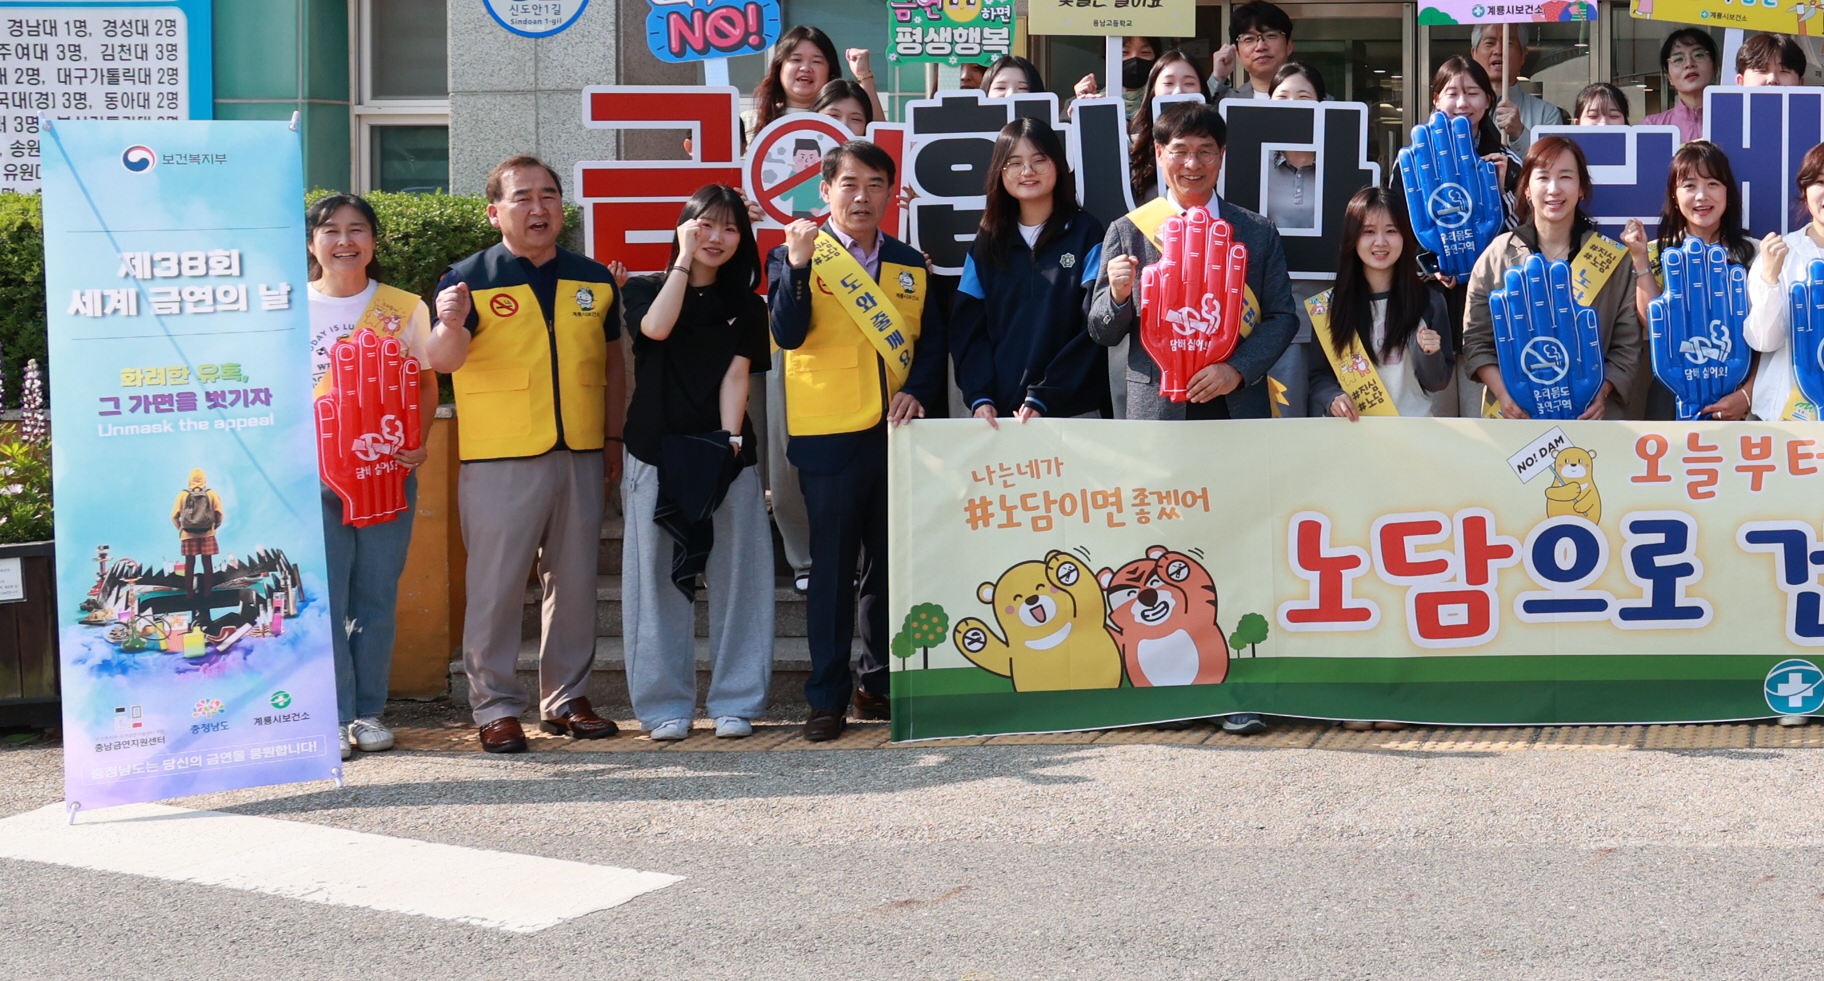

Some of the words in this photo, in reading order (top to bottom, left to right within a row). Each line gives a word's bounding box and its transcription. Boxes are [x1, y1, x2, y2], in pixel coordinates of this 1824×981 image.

[509, 3, 562, 16] 신도안1길
[981, 5, 1011, 22] 하면
[1487, 3, 1544, 16] 계룡시보건소
[1709, 10, 1748, 23] 계룡시보건소
[7, 19, 57, 37] 경남대
[64, 19, 92, 37] 1명,
[103, 19, 149, 37] 경성대
[155, 19, 177, 37] 2명
[545, 18, 562, 26] 1-gil
[667, 2, 763, 59] NO!
[1093, 19, 1133, 28] 용남고등학교
[895, 26, 1010, 57] 평생행복
[57, 68, 151, 86] 대구가톨릭대
[157, 68, 178, 85] 2명
[162, 153, 227, 165] 보건복지부
[118, 249, 241, 279] 제38회
[67, 288, 138, 317] 세계
[149, 284, 248, 315] 금연의
[259, 283, 291, 311] 날
[120, 367, 190, 387] 화려한
[197, 363, 248, 383] 유혹,
[99, 397, 122, 416] 그
[129, 391, 197, 413] 가면을
[205, 388, 272, 409] 벗기자
[98, 421, 174, 437] Unmask
[178, 418, 209, 431] the
[214, 413, 274, 430] appeal
[1517, 454, 1538, 474] NO!
[1539, 435, 1564, 458] DAM
[971, 456, 1065, 488] 나는네가
[963, 487, 1125, 531] #노담이면
[1130, 487, 1210, 525] 좋겠어
[1285, 514, 1705, 641] 노담으로
[190, 721, 229, 734] 충청남도
[254, 711, 310, 726] 계룡시보건소
[94, 736, 166, 752] 충남금연지원센터
[162, 756, 202, 770] 당신의
[206, 751, 246, 765] 금연을
[249, 741, 318, 759] 응원합니다!
